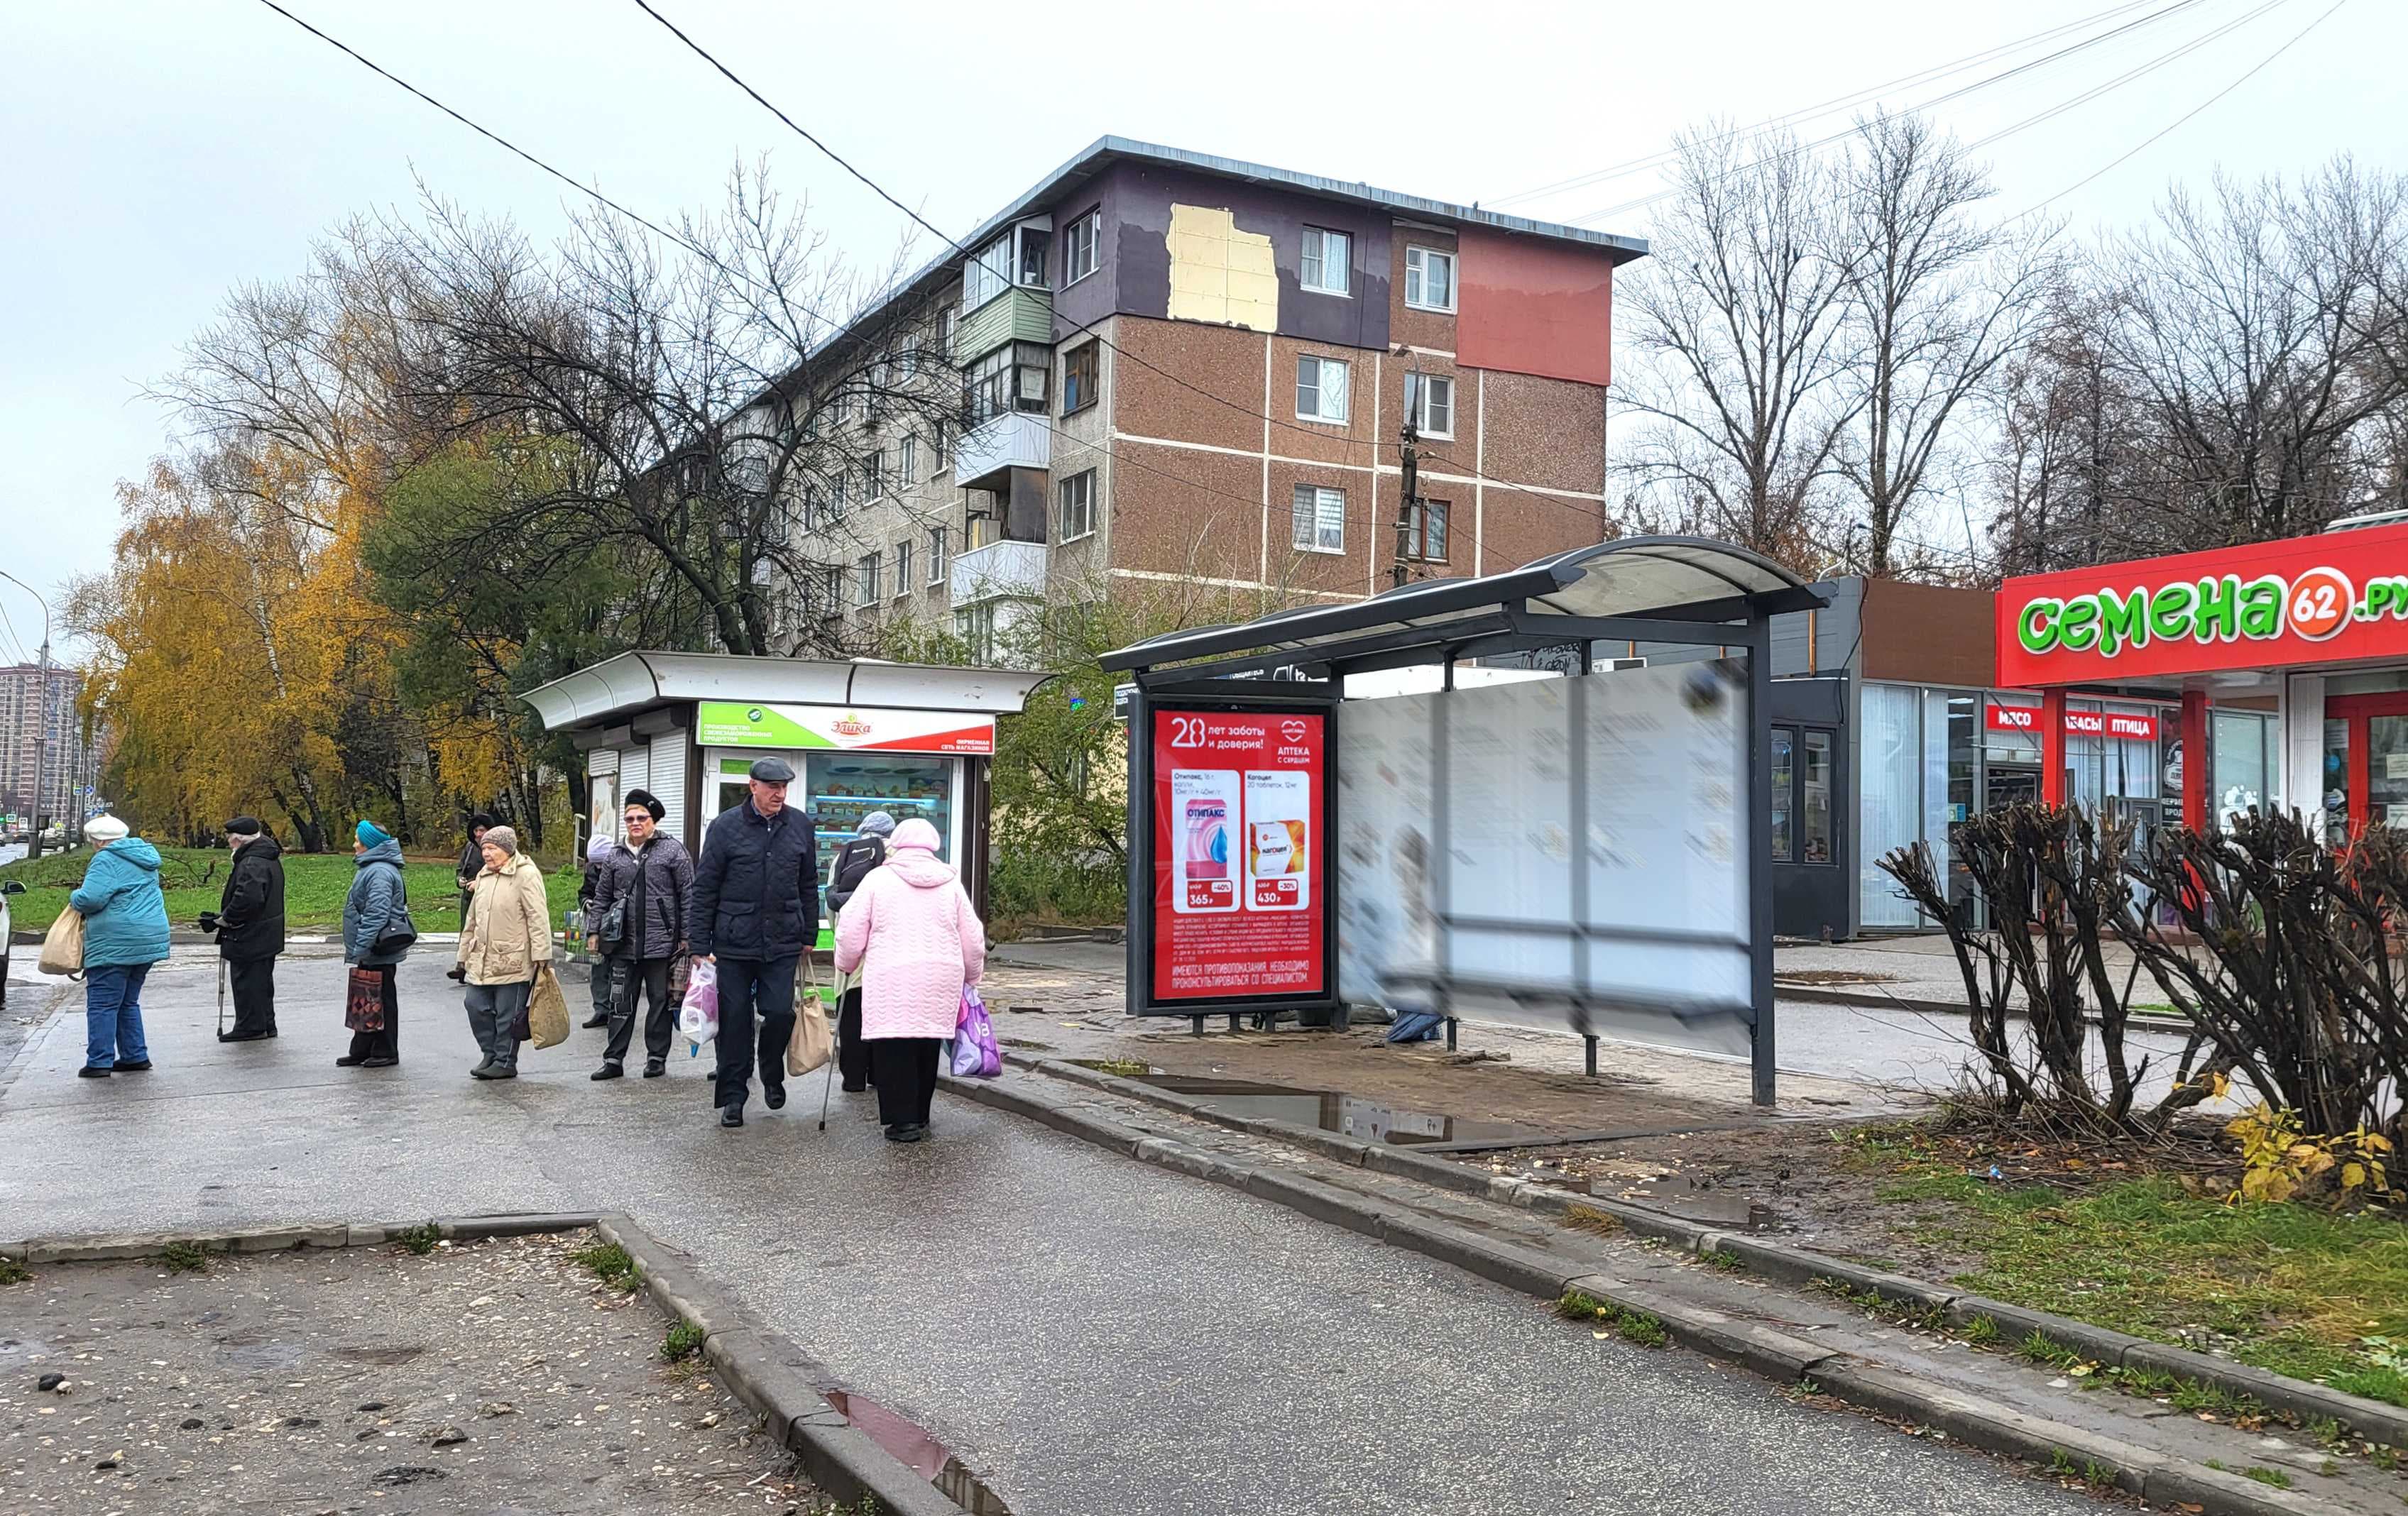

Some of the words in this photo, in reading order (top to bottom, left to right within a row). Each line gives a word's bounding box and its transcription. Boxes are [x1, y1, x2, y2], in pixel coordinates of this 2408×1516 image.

[1998, 711, 2032, 726] МЯСО
[1171, 717, 1205, 747] 28
[1228, 725, 1265, 736] заботы
[2111, 719, 2150, 736] ПТИЦА
[1217, 739, 1264, 751] доверия!
[1278, 747, 1310, 755] АПТЕКА
[1187, 808, 1225, 817] ОТИПАКС
[1172, 965, 1203, 976] ИМЕЮТСЯ
[1270, 960, 1309, 972] НЕОБХОДИМО
[1251, 974, 1259, 985] СО
